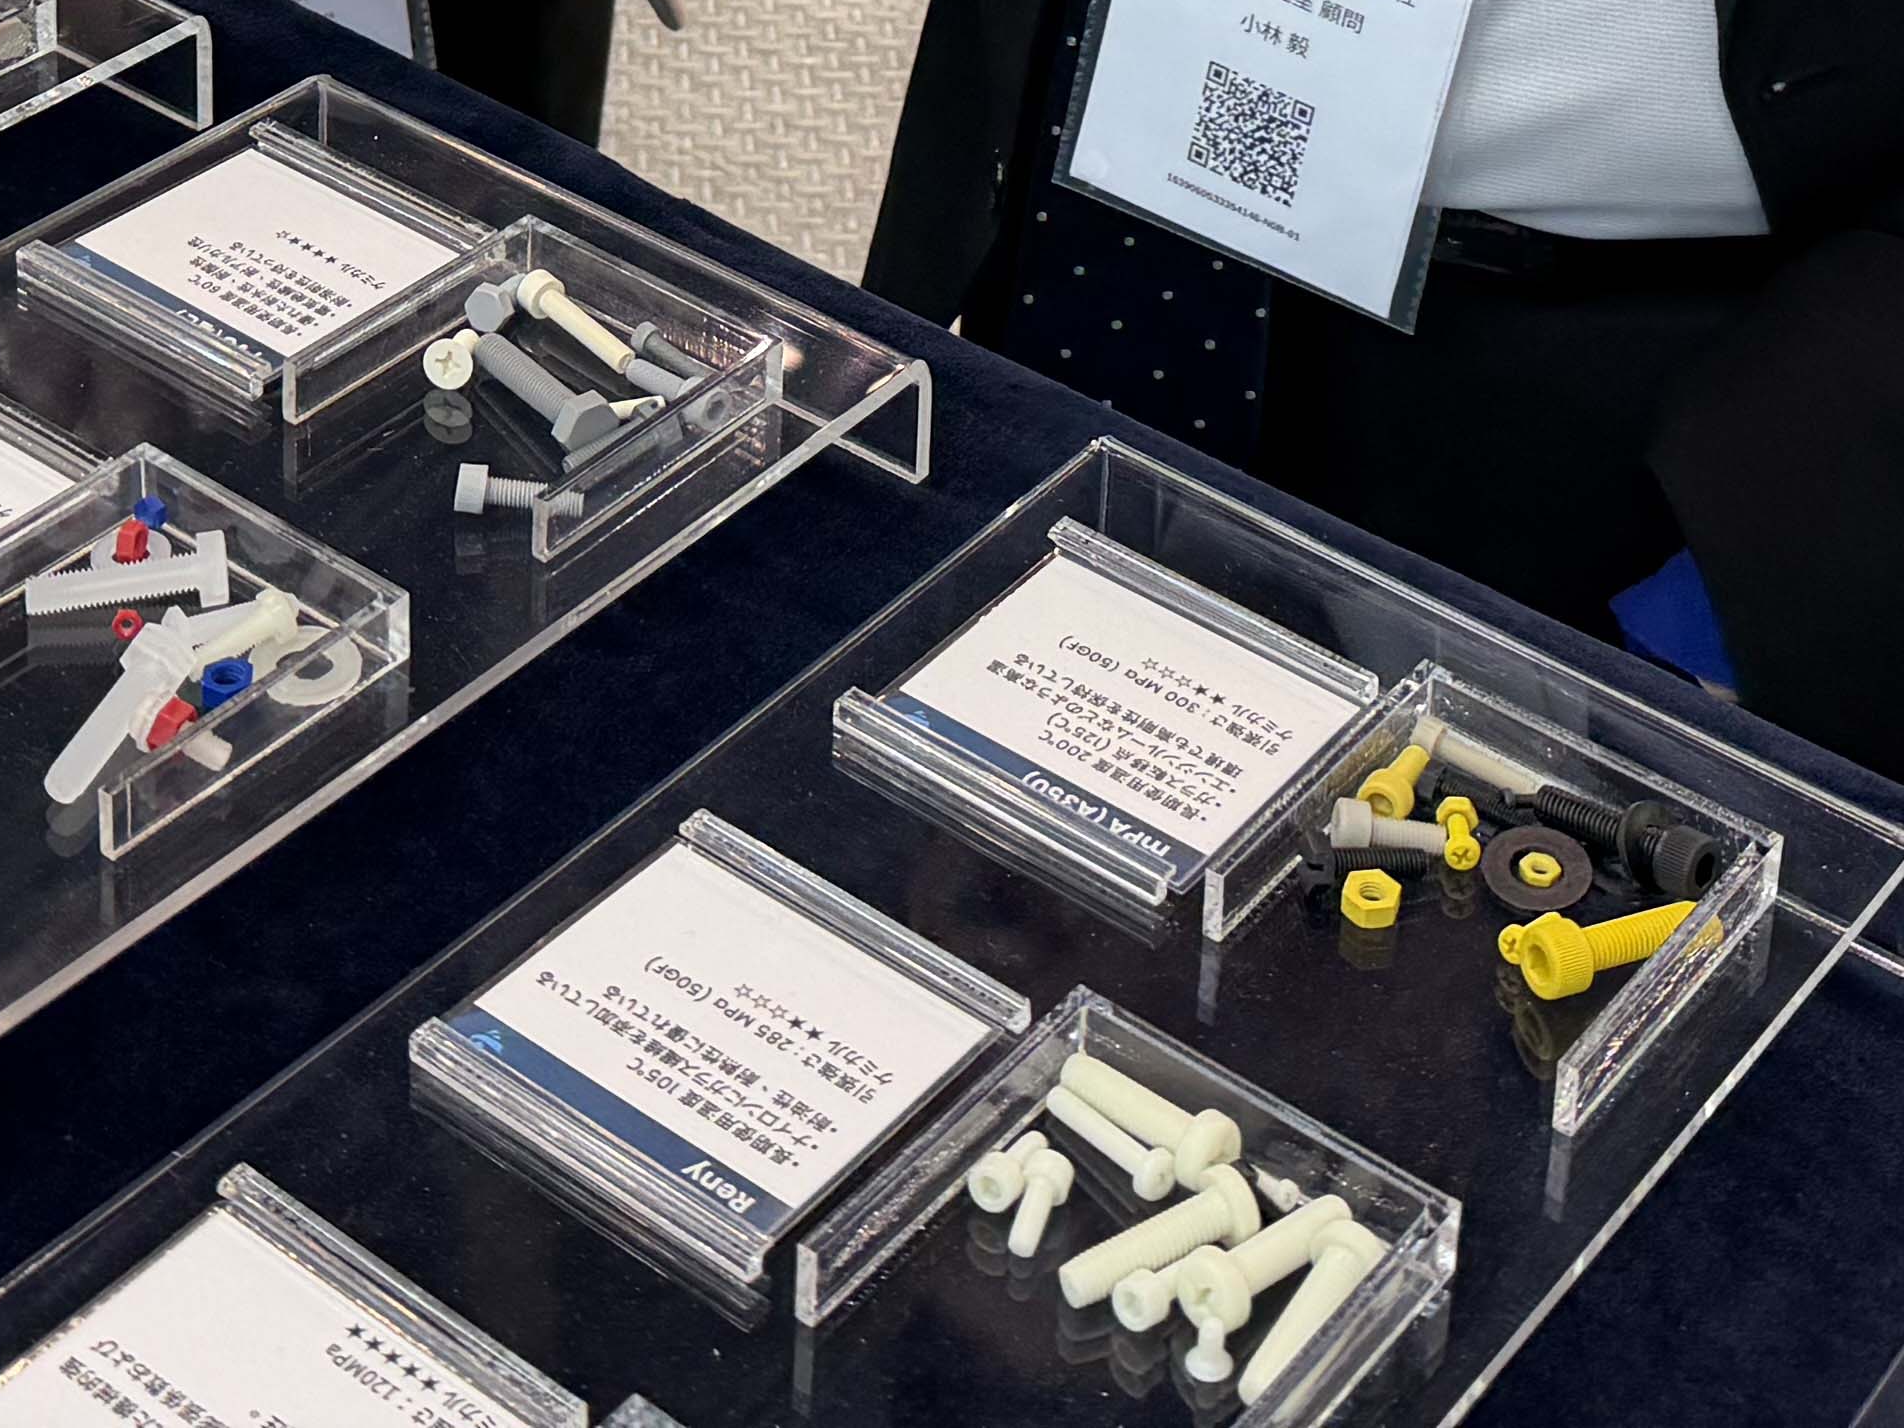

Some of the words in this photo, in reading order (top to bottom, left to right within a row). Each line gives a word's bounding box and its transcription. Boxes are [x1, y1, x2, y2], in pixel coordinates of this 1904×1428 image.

[1240, 13, 1283, 46] 小林
[1318, 0, 1365, 35] 顧問
[340, 263, 386, 290] ケミカル
[1058, 635, 1120, 673] (50GF)
[1123, 668, 1164, 694] MPa
[1164, 691, 1201, 714] 300
[986, 659, 1231, 792] エンジンルームなどのような高温
[1013, 653, 1244, 779] 環境でも高剛性を保持している
[1046, 712, 1112, 752] (125℃)
[1231, 704, 1293, 741] ケミカル
[1090, 757, 1201, 821] 長期使用温度
[1111, 746, 1217, 806] ガラス転移点
[1100, 817, 1172, 861] mPA
[644, 956, 713, 1003] (50GF)
[712, 997, 757, 1028] MPa
[535, 971, 812, 1147] ナイロンにガラス繊維を添加している
[602, 985, 833, 1133] 耐油性、耐熱性に優れている
[753, 1024, 795, 1052] 285
[827, 1040, 894, 1086] ケミカル
[677, 1088, 795, 1165] 長期使用温度
[680, 1160, 757, 1214] Reny
